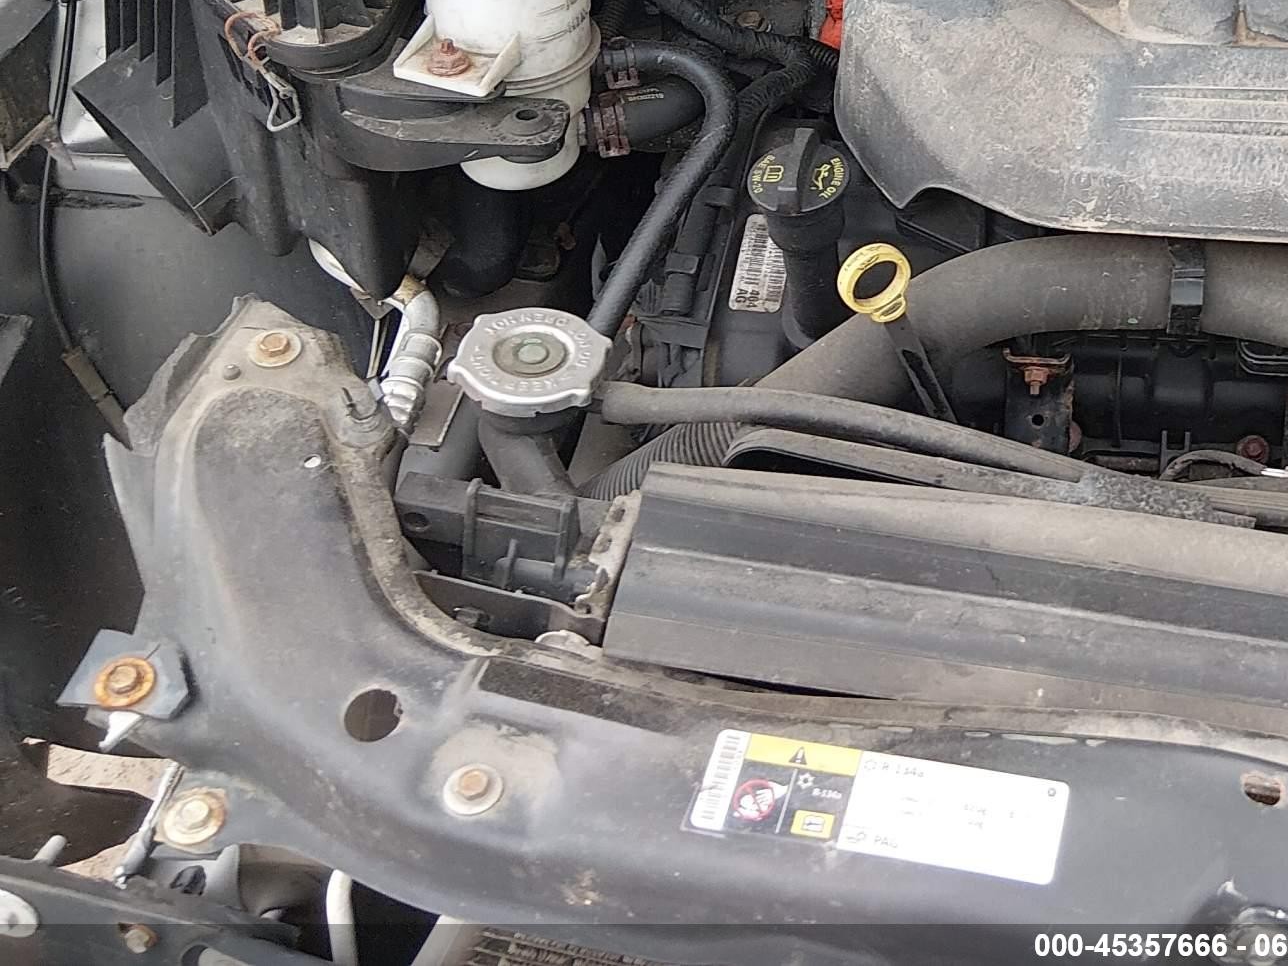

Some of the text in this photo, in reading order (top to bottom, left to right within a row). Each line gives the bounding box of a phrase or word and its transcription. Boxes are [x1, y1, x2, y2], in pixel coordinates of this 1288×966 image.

[759, 154, 776, 172] SAE
[818, 157, 845, 200] ENGINE OIL
[734, 288, 747, 305] AG
